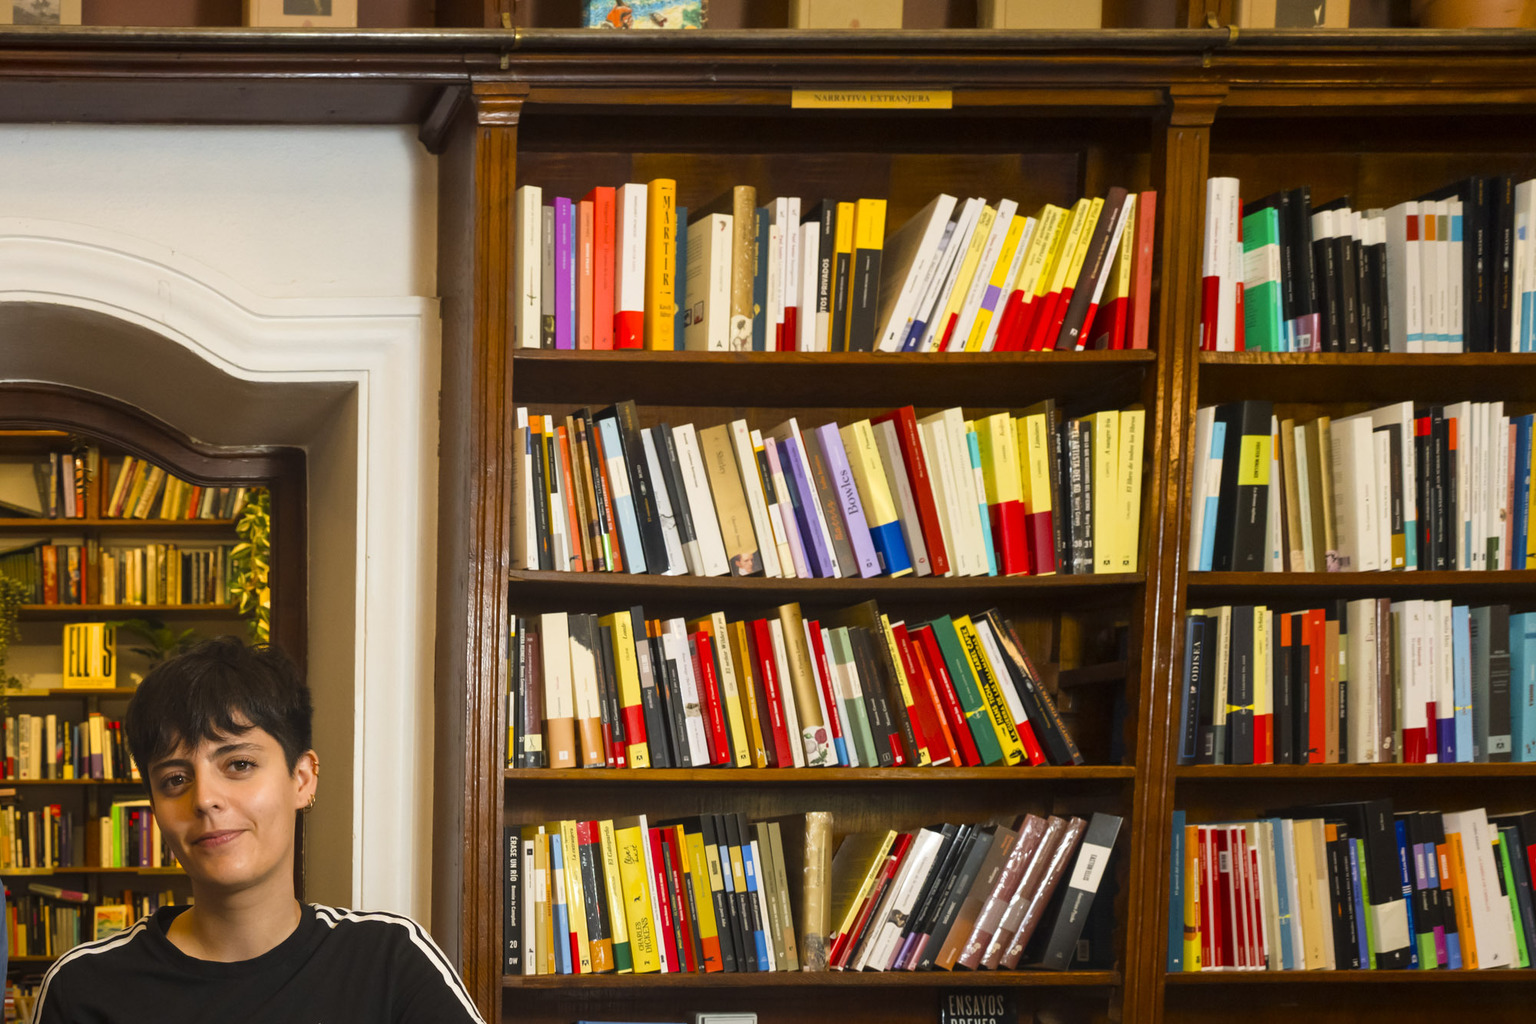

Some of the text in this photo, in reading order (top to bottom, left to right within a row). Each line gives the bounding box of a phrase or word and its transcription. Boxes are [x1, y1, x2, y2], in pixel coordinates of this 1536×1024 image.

[814, 94, 930, 104] NARRATIVA EXTRANJERA
[820, 259, 830, 296] PRIVADOS
[840, 469, 859, 515] Bowles
[1365, 617, 1374, 643] Fiesta
[971, 635, 994, 685] SALAMANDRAS
[1191, 641, 1201, 682] ODISEA
[1000, 707, 1014, 731] GUERRA
[509, 940, 517, 949] 20
[635, 921, 645, 951] CHARLES
[641, 917, 652, 954] DICKENS
[948, 995, 1005, 1016] ENSAYOS
